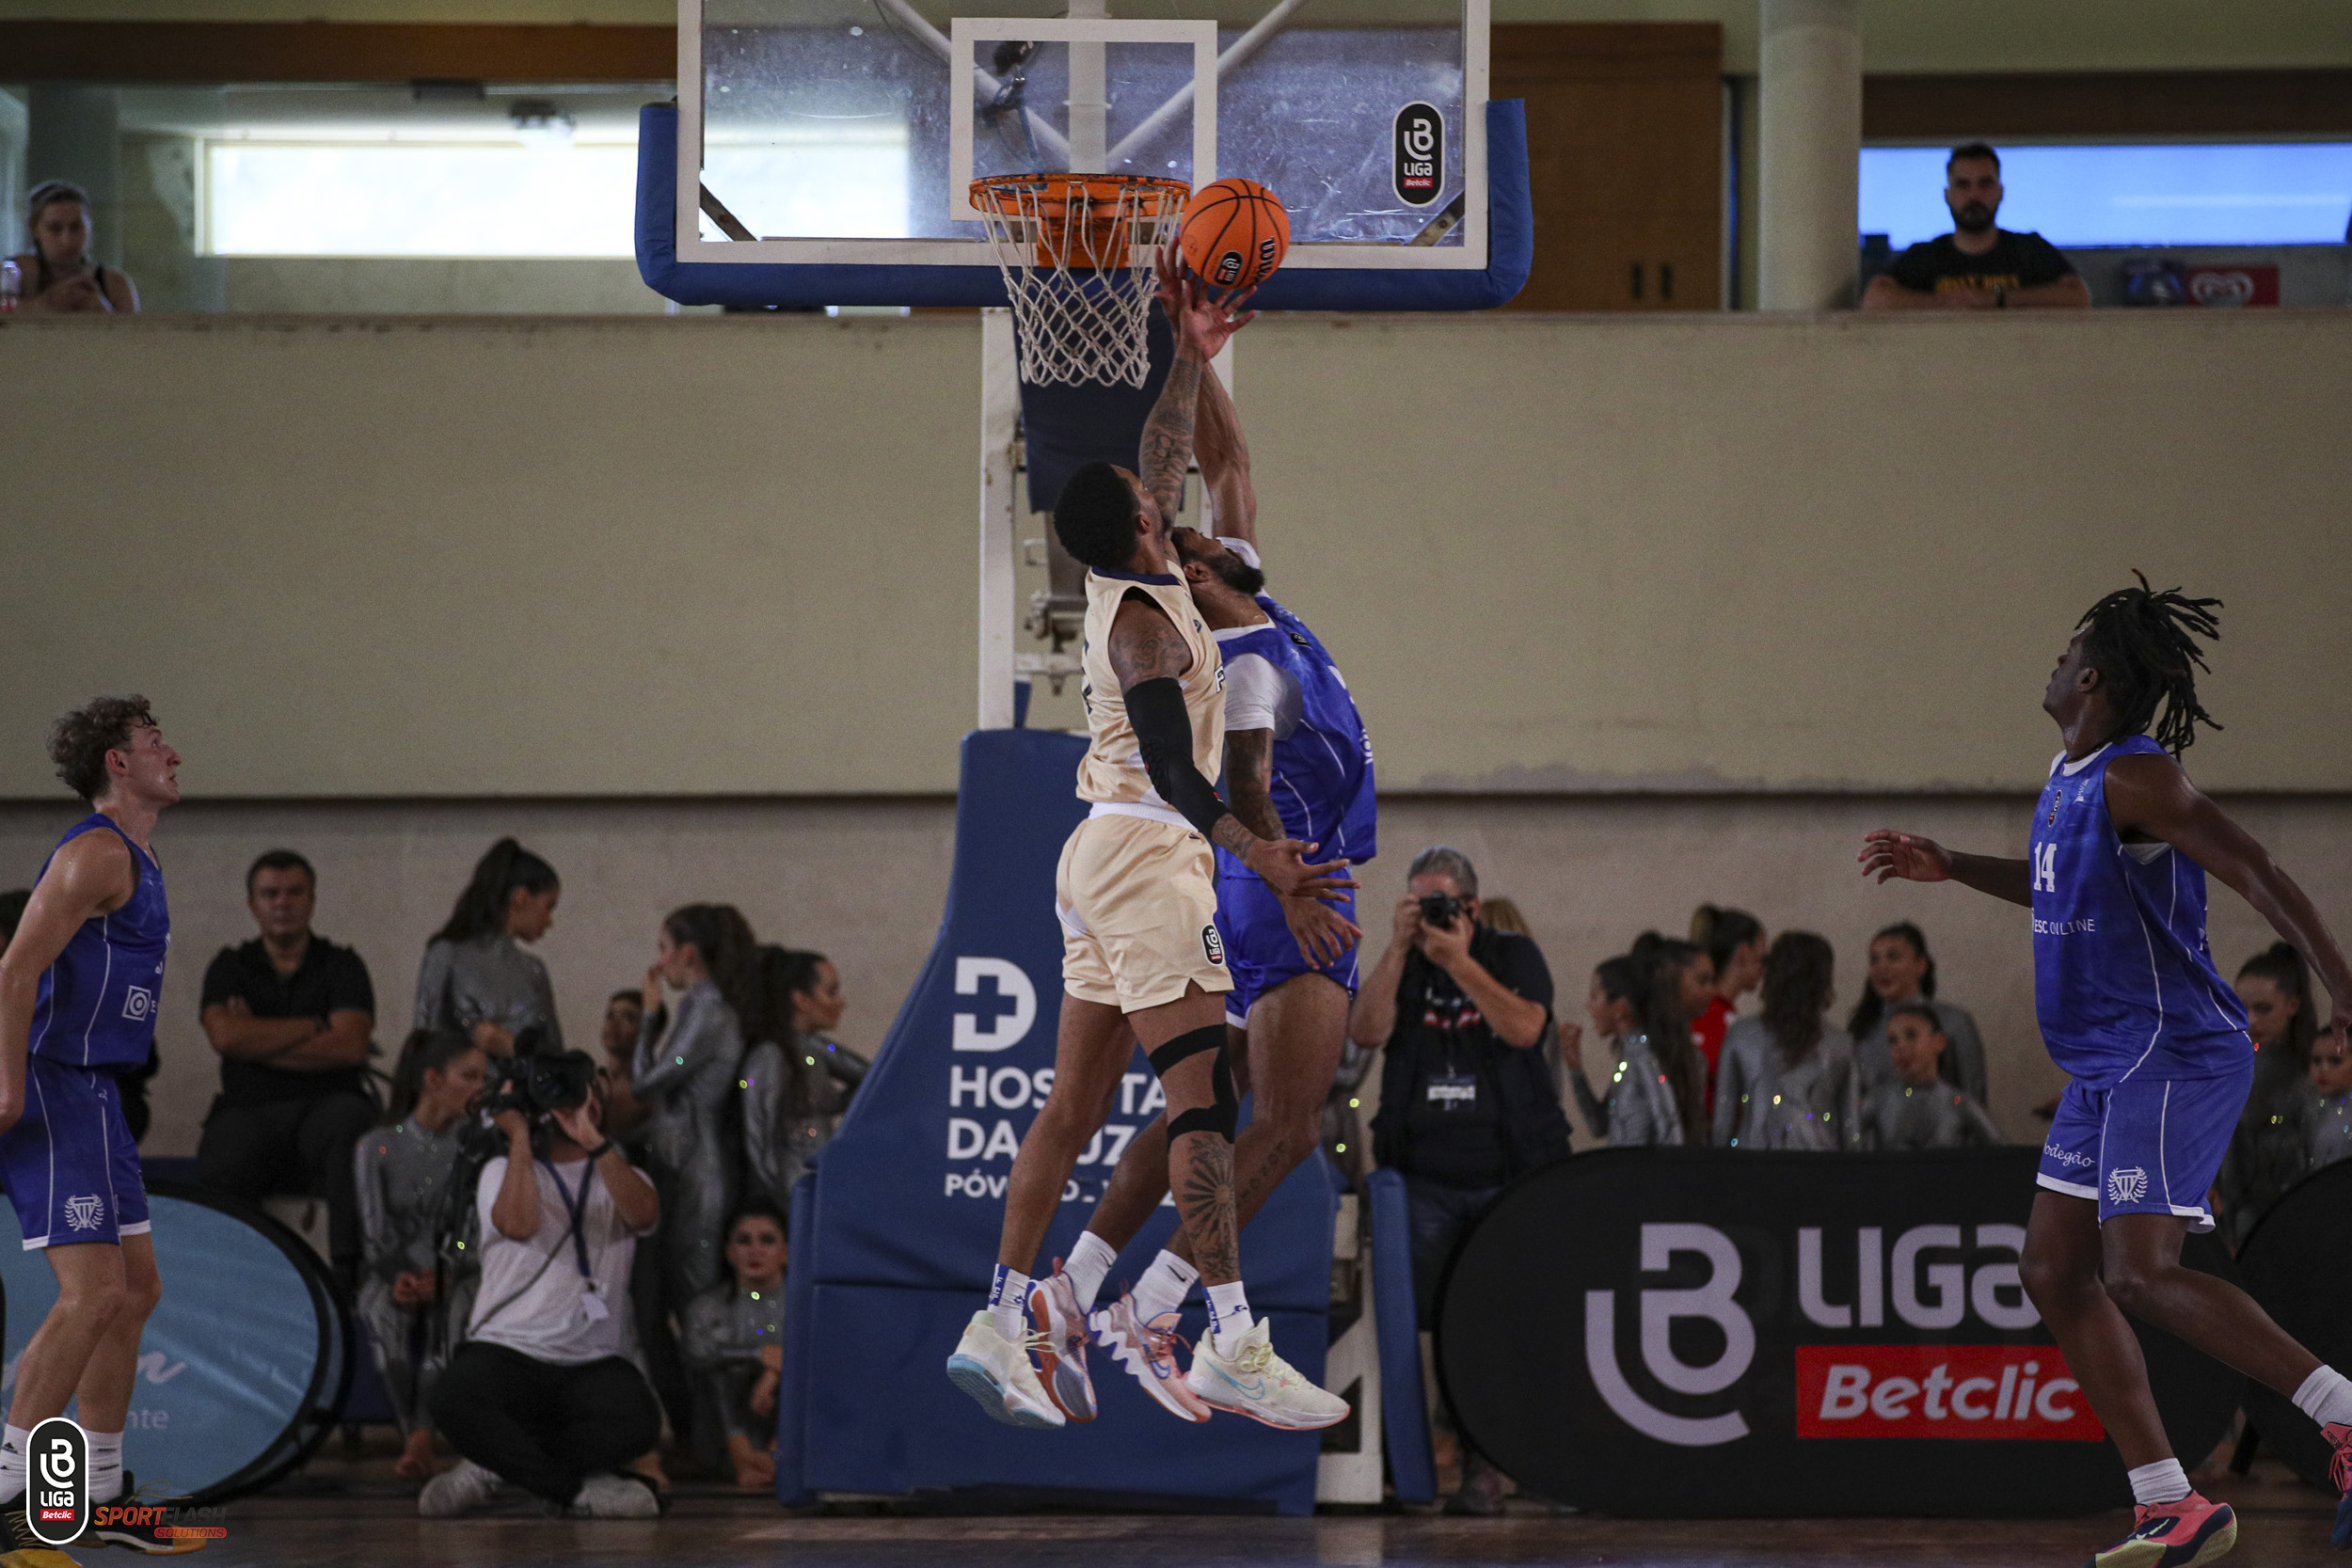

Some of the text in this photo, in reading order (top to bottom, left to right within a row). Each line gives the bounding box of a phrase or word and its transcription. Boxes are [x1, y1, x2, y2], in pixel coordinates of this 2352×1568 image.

[2033, 842, 2058, 893] 14
[2050, 919, 2095, 936] ONLINE
[950, 1066, 1168, 1116] HOSTA
[946, 1117, 1137, 1166] DA UZ
[945, 1168, 1009, 1199] PÓV
[1820, 1360, 2079, 1422] Betclic
